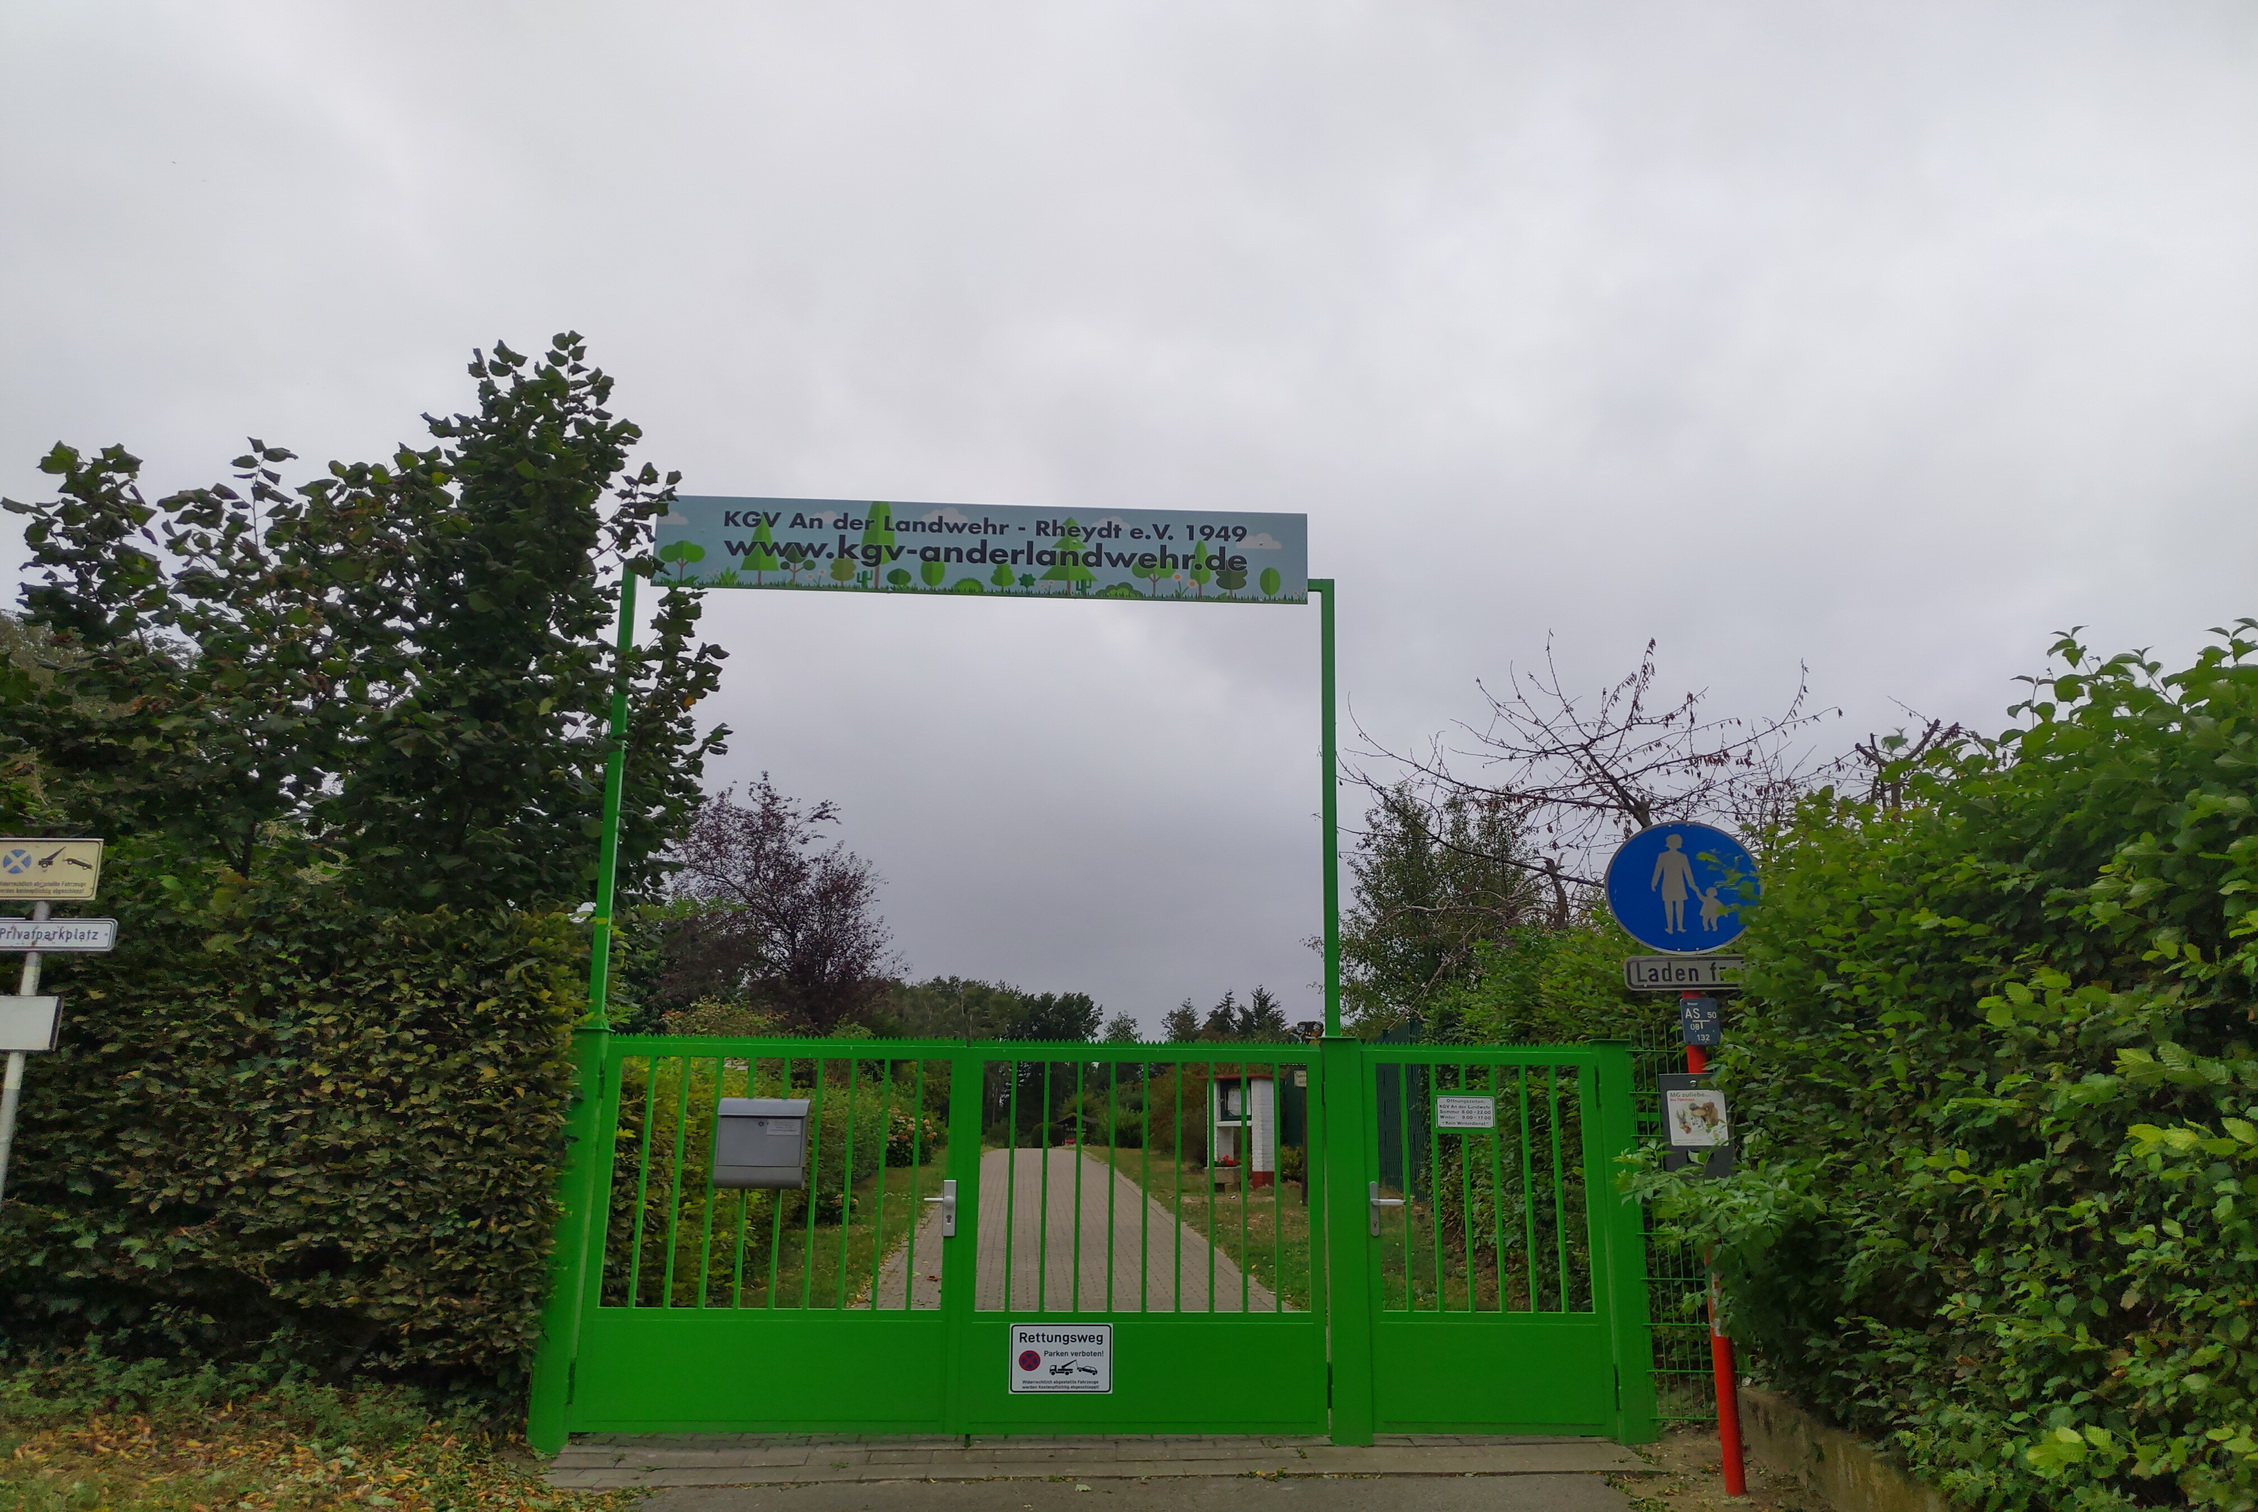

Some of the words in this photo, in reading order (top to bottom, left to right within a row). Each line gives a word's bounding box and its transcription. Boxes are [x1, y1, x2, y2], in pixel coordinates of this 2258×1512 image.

[723, 510, 782, 528] KGV
[788, 512, 824, 530] An
[832, 512, 875, 531] der
[883, 515, 1010, 536] Landwehr
[1035, 519, 1122, 543] Rheydt
[1129, 523, 1174, 541] e.V.
[1186, 524, 1248, 542] 1949
[723, 534, 1249, 572] www.kgv-anderlandwehr.de
[0, 926, 99, 943] Privatparkplatz
[1636, 961, 1699, 983] Laden
[1685, 1007, 1701, 1019] AS
[1706, 1011, 1717, 1019] 50
[1019, 1331, 1104, 1346] Rettungsweg
[1043, 1349, 1068, 1357] Parken
[1070, 1349, 1105, 1357] verboten!
